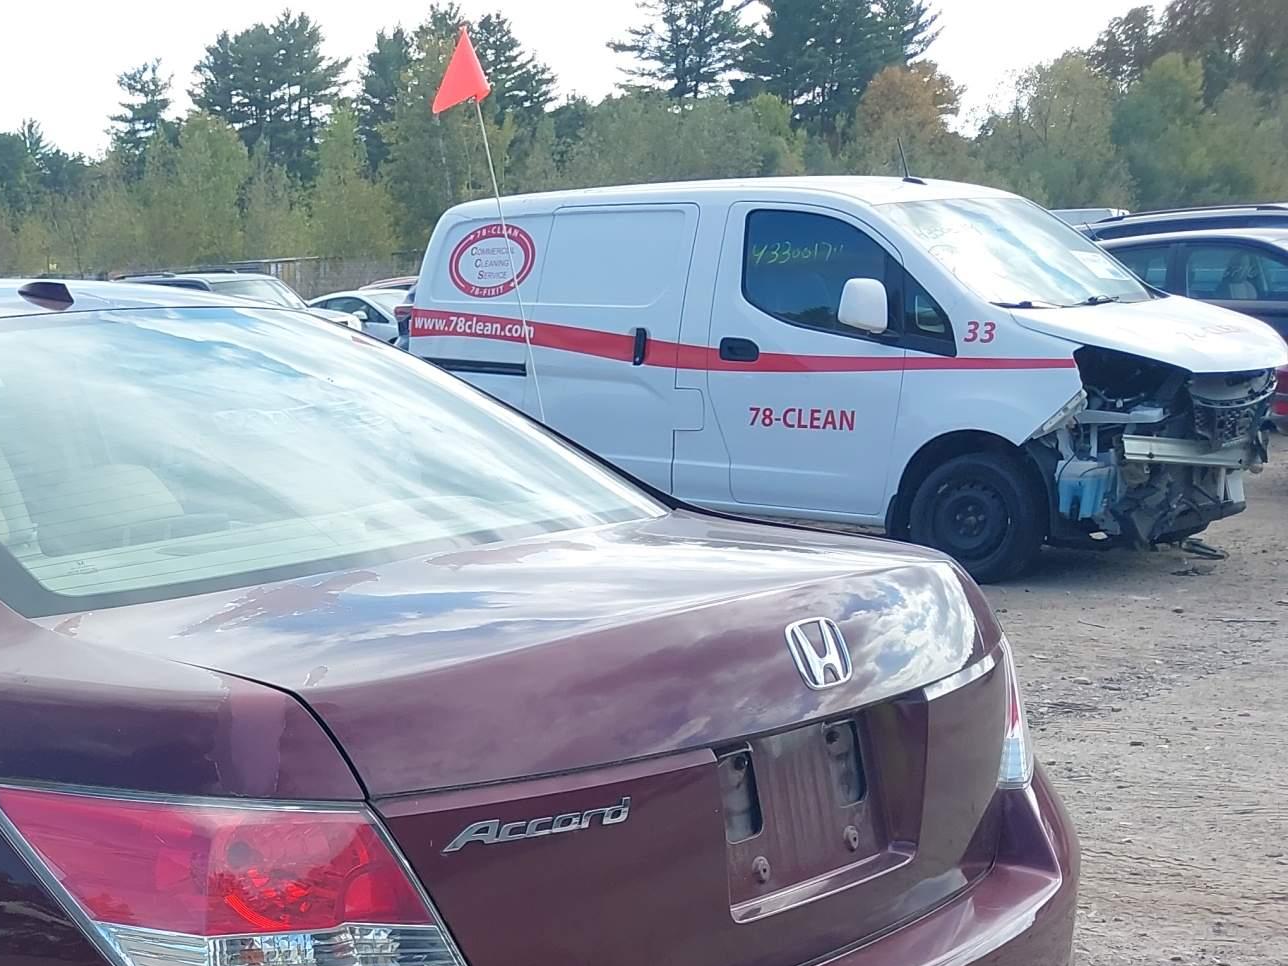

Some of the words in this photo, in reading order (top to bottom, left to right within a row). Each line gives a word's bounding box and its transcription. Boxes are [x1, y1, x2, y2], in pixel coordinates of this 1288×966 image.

[414, 316, 534, 338] www.78clean.com
[964, 321, 996, 344] 33
[748, 407, 856, 431] 78-CLEAN
[442, 797, 631, 852] Accord
